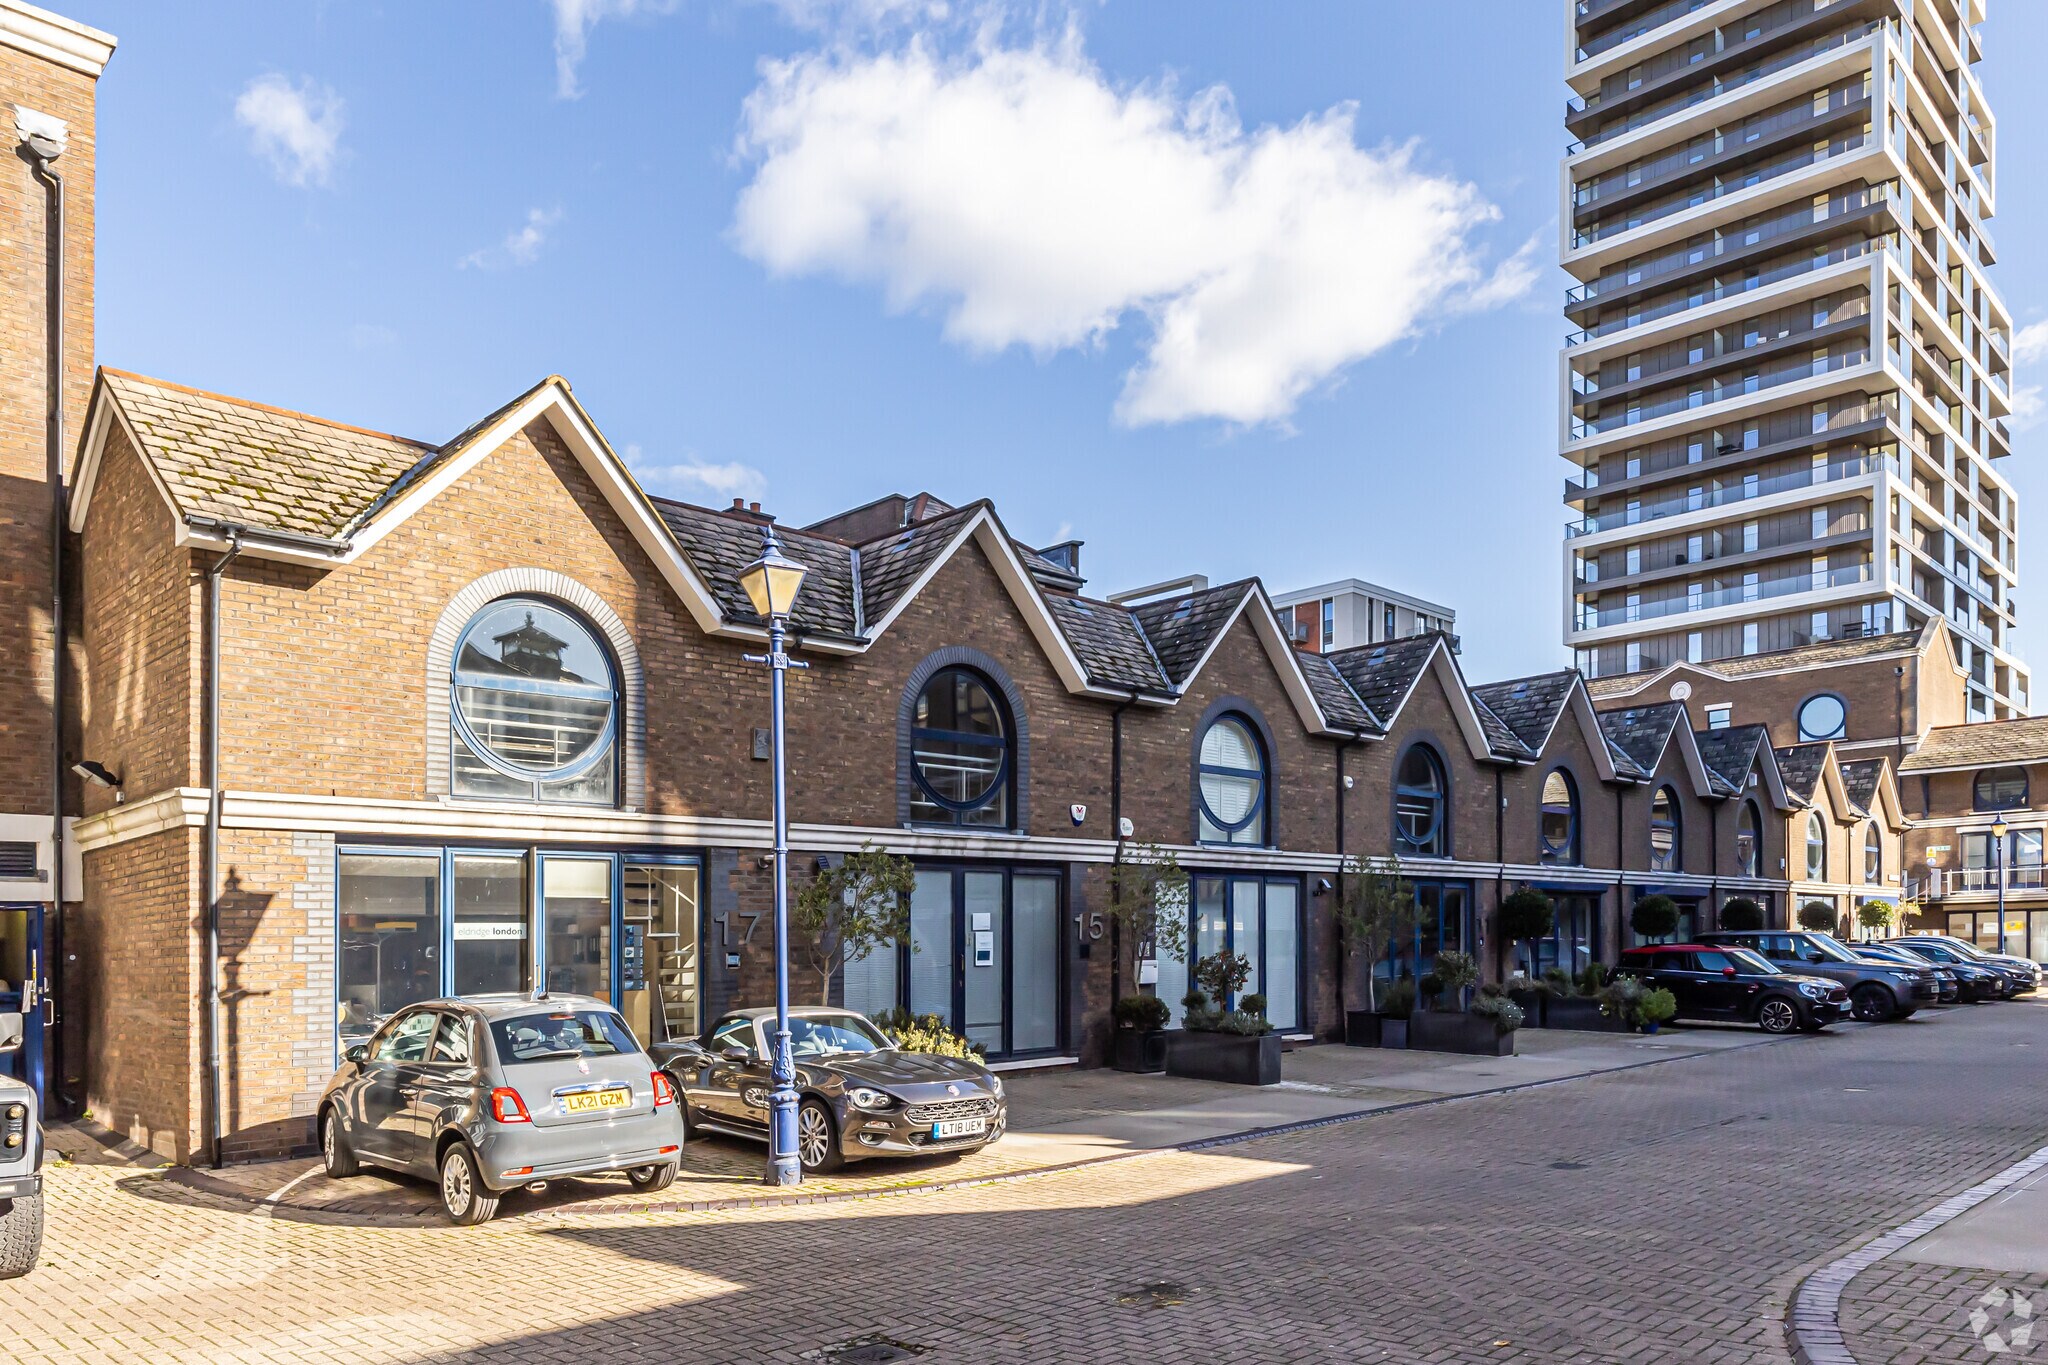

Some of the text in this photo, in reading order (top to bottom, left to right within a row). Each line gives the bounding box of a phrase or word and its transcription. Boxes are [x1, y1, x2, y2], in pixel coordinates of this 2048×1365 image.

[492, 927, 523, 935] london
[714, 911, 763, 946] 17
[1074, 912, 1104, 940] 15
[568, 1096, 598, 1110] LK21
[600, 1092, 625, 1106] GZM
[942, 1122, 963, 1135] LT18
